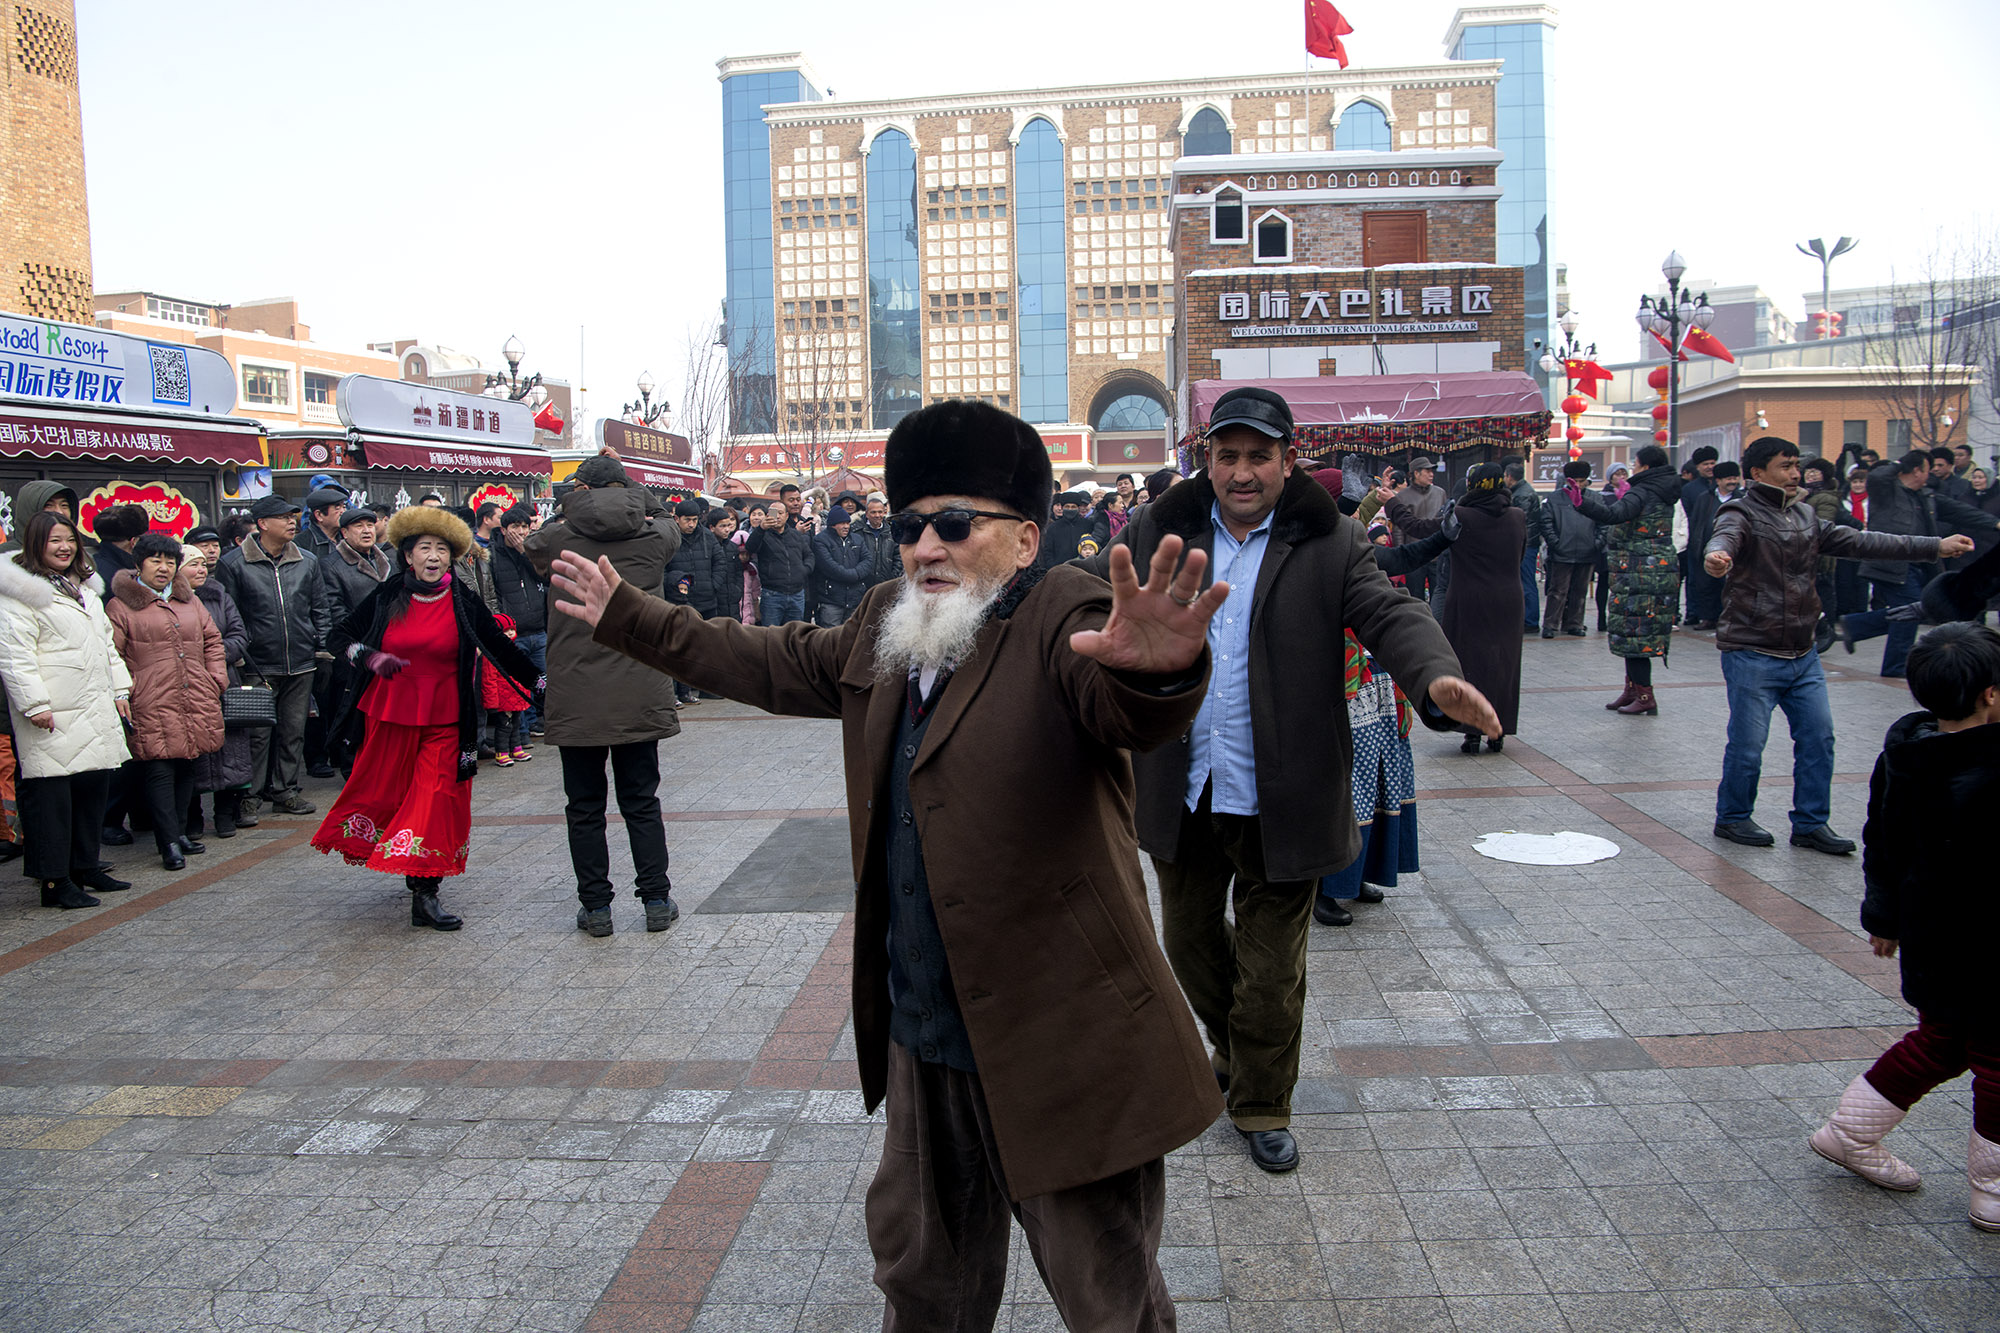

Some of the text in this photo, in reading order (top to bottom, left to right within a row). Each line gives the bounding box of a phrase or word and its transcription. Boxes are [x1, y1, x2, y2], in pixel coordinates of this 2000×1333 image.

[1219, 286, 1493, 321] 国际大巴扎景区
[0, 323, 109, 363] road Resort
[1233, 321, 1477, 336] WELCOME TO THE INTERNATIONAL GRAND BAZAAR
[437, 402, 500, 434] 新疆味道
